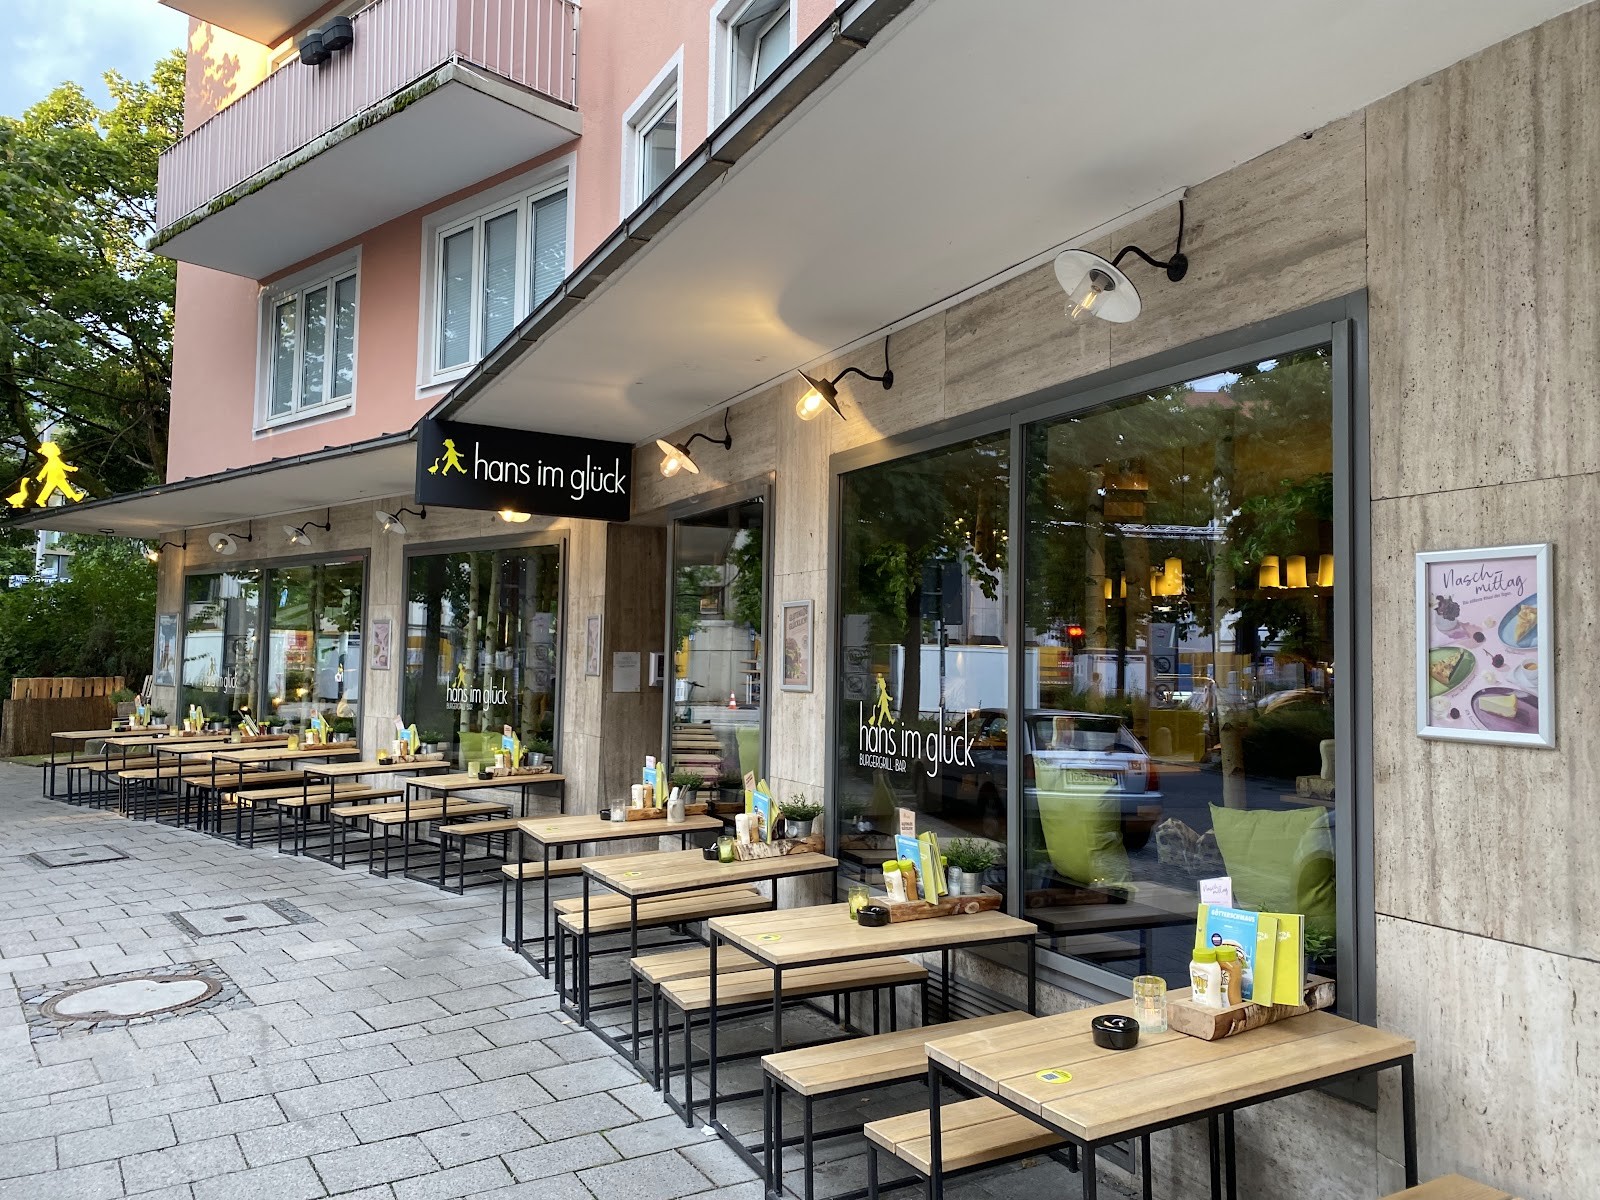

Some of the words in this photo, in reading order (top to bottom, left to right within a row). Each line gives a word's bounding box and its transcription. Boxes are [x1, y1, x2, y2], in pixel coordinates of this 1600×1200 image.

[474, 441, 531, 485] hans
[537, 460, 564, 488] im
[570, 454, 626, 501] glück
[1475, 573, 1528, 597] mittag
[446, 675, 468, 703] hans
[469, 684, 482, 704] im
[482, 676, 508, 712] glück
[859, 700, 897, 756] hans
[901, 721, 921, 759] im
[926, 706, 976, 778] glück
